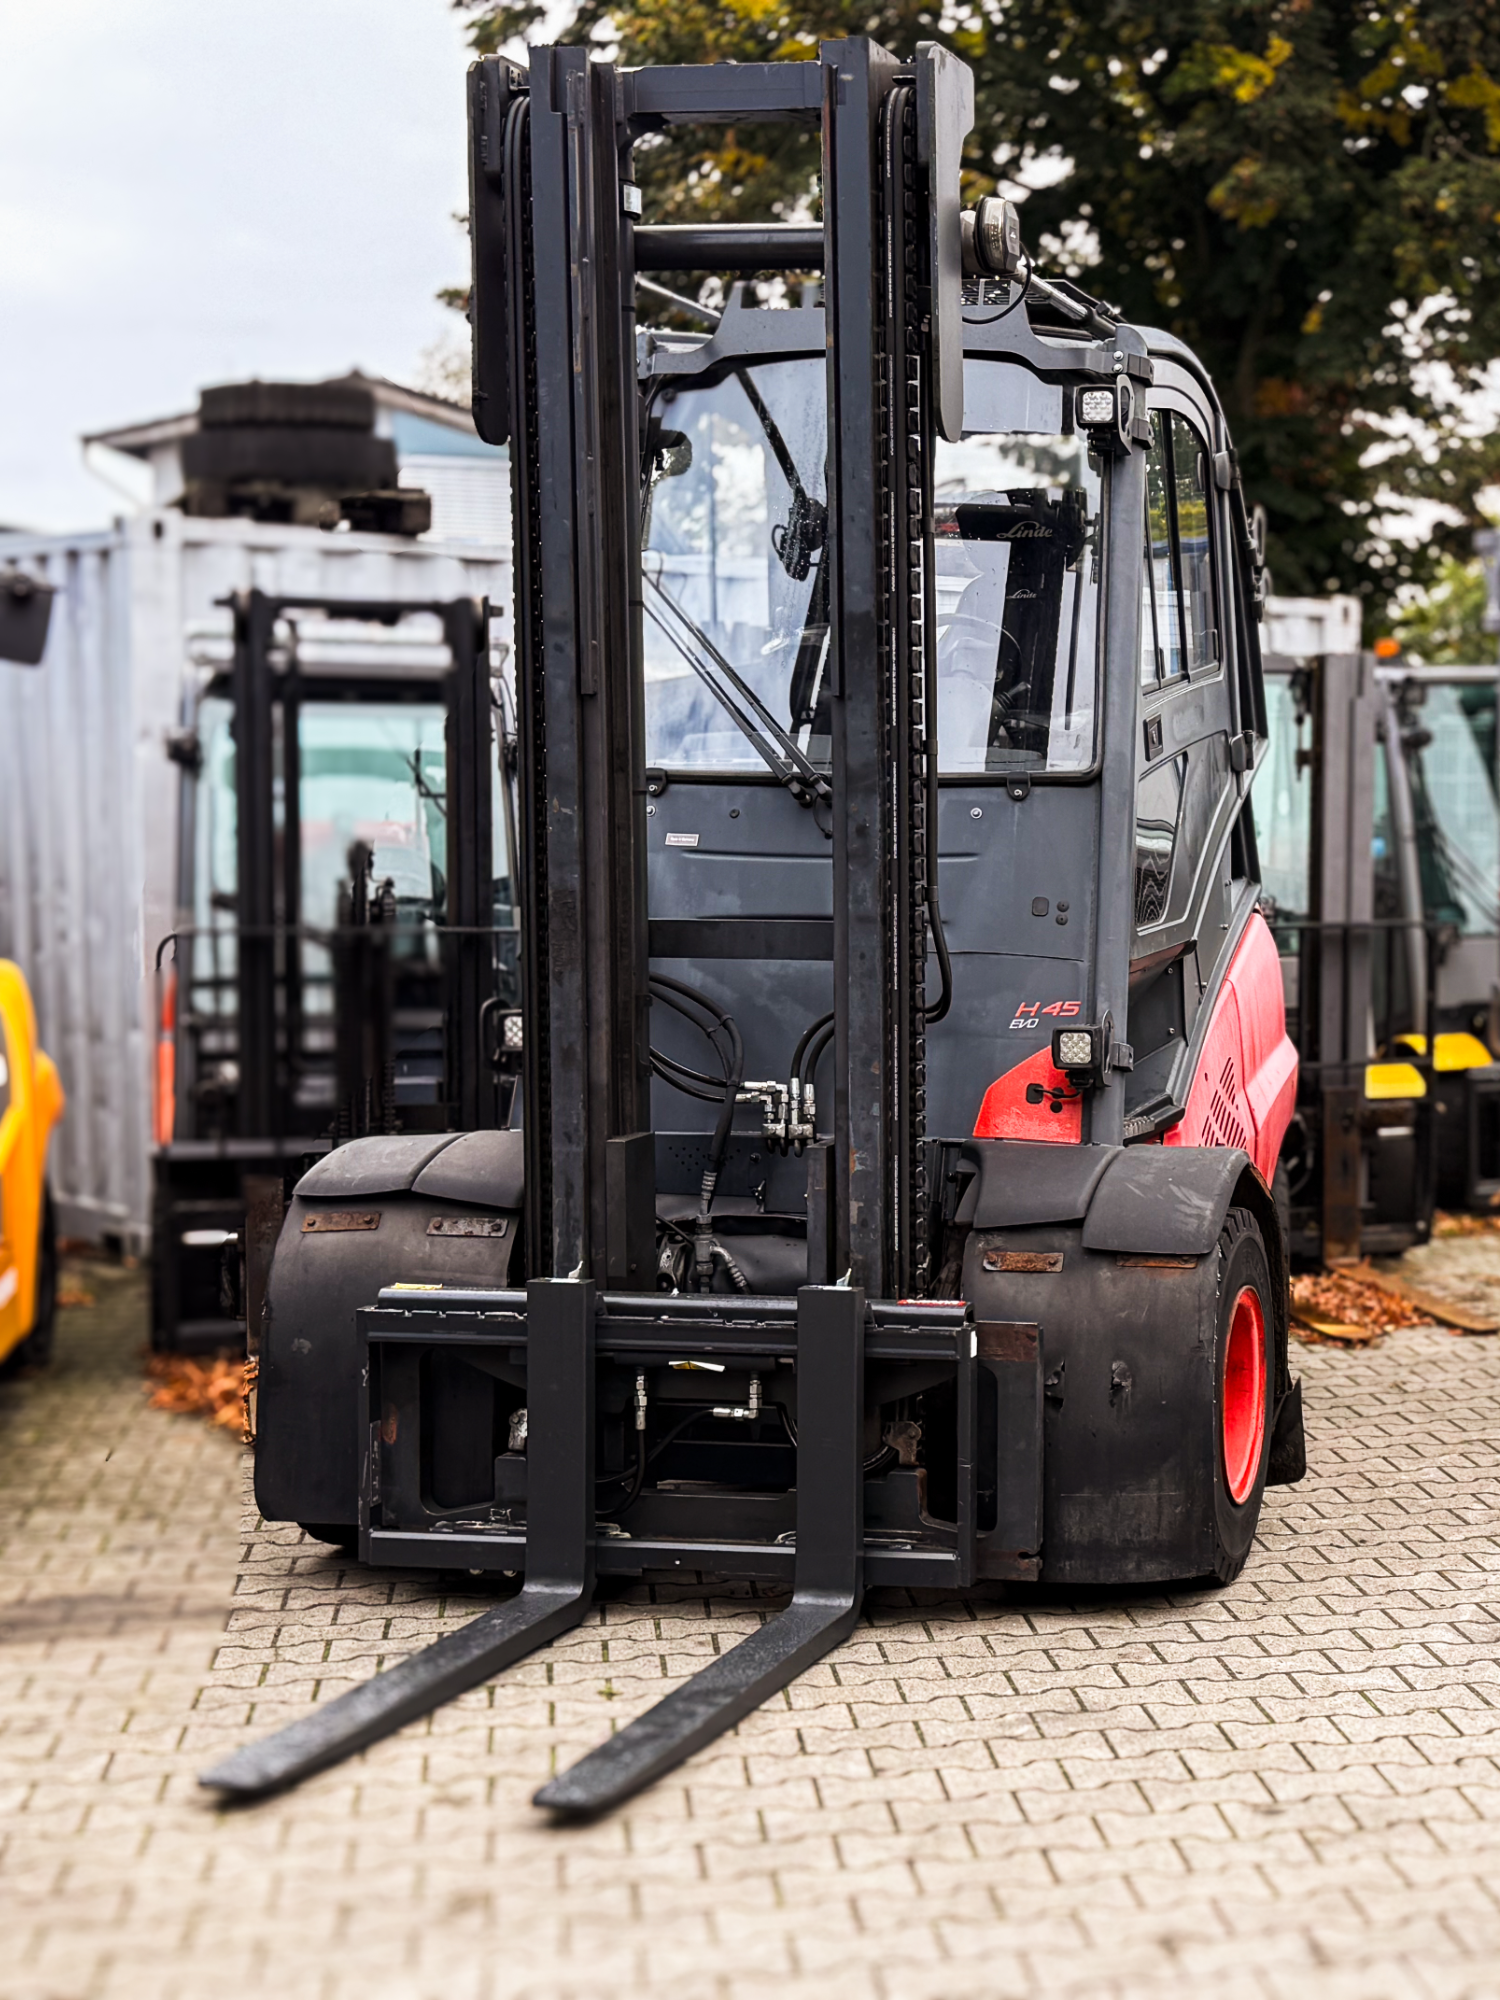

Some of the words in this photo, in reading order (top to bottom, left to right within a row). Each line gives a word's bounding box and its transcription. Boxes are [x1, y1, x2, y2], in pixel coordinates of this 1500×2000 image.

[996, 521, 1053, 539] Linde
[1006, 589, 1037, 599] Linde
[1014, 1001, 1041, 1018] H
[1041, 1000, 1082, 1017] 45
[1009, 1018, 1039, 1029] EVO
